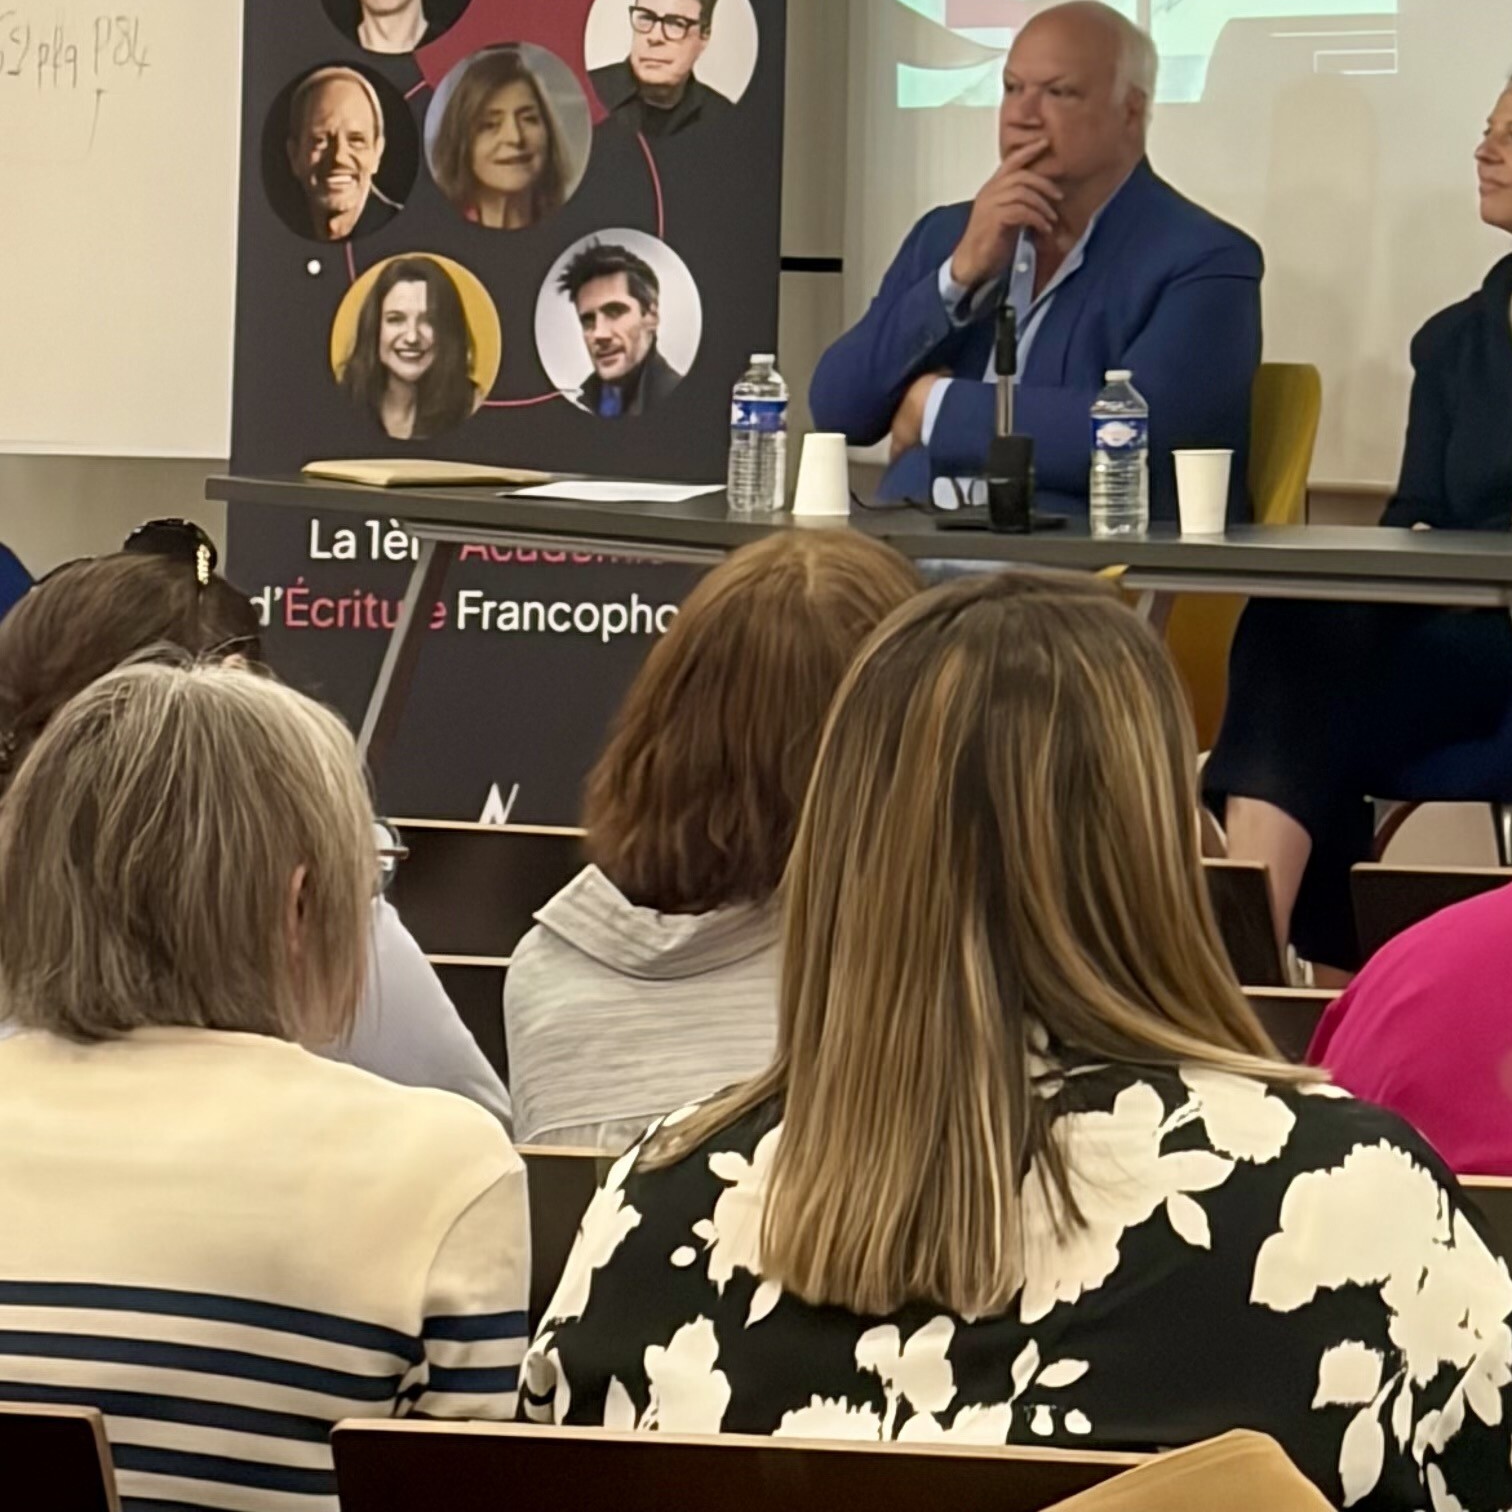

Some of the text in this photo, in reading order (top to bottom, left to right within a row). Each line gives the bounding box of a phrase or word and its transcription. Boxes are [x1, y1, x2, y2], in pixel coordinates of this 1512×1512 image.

[310, 518, 357, 560] La
[249, 575, 680, 643] d'Écritue Francopho
